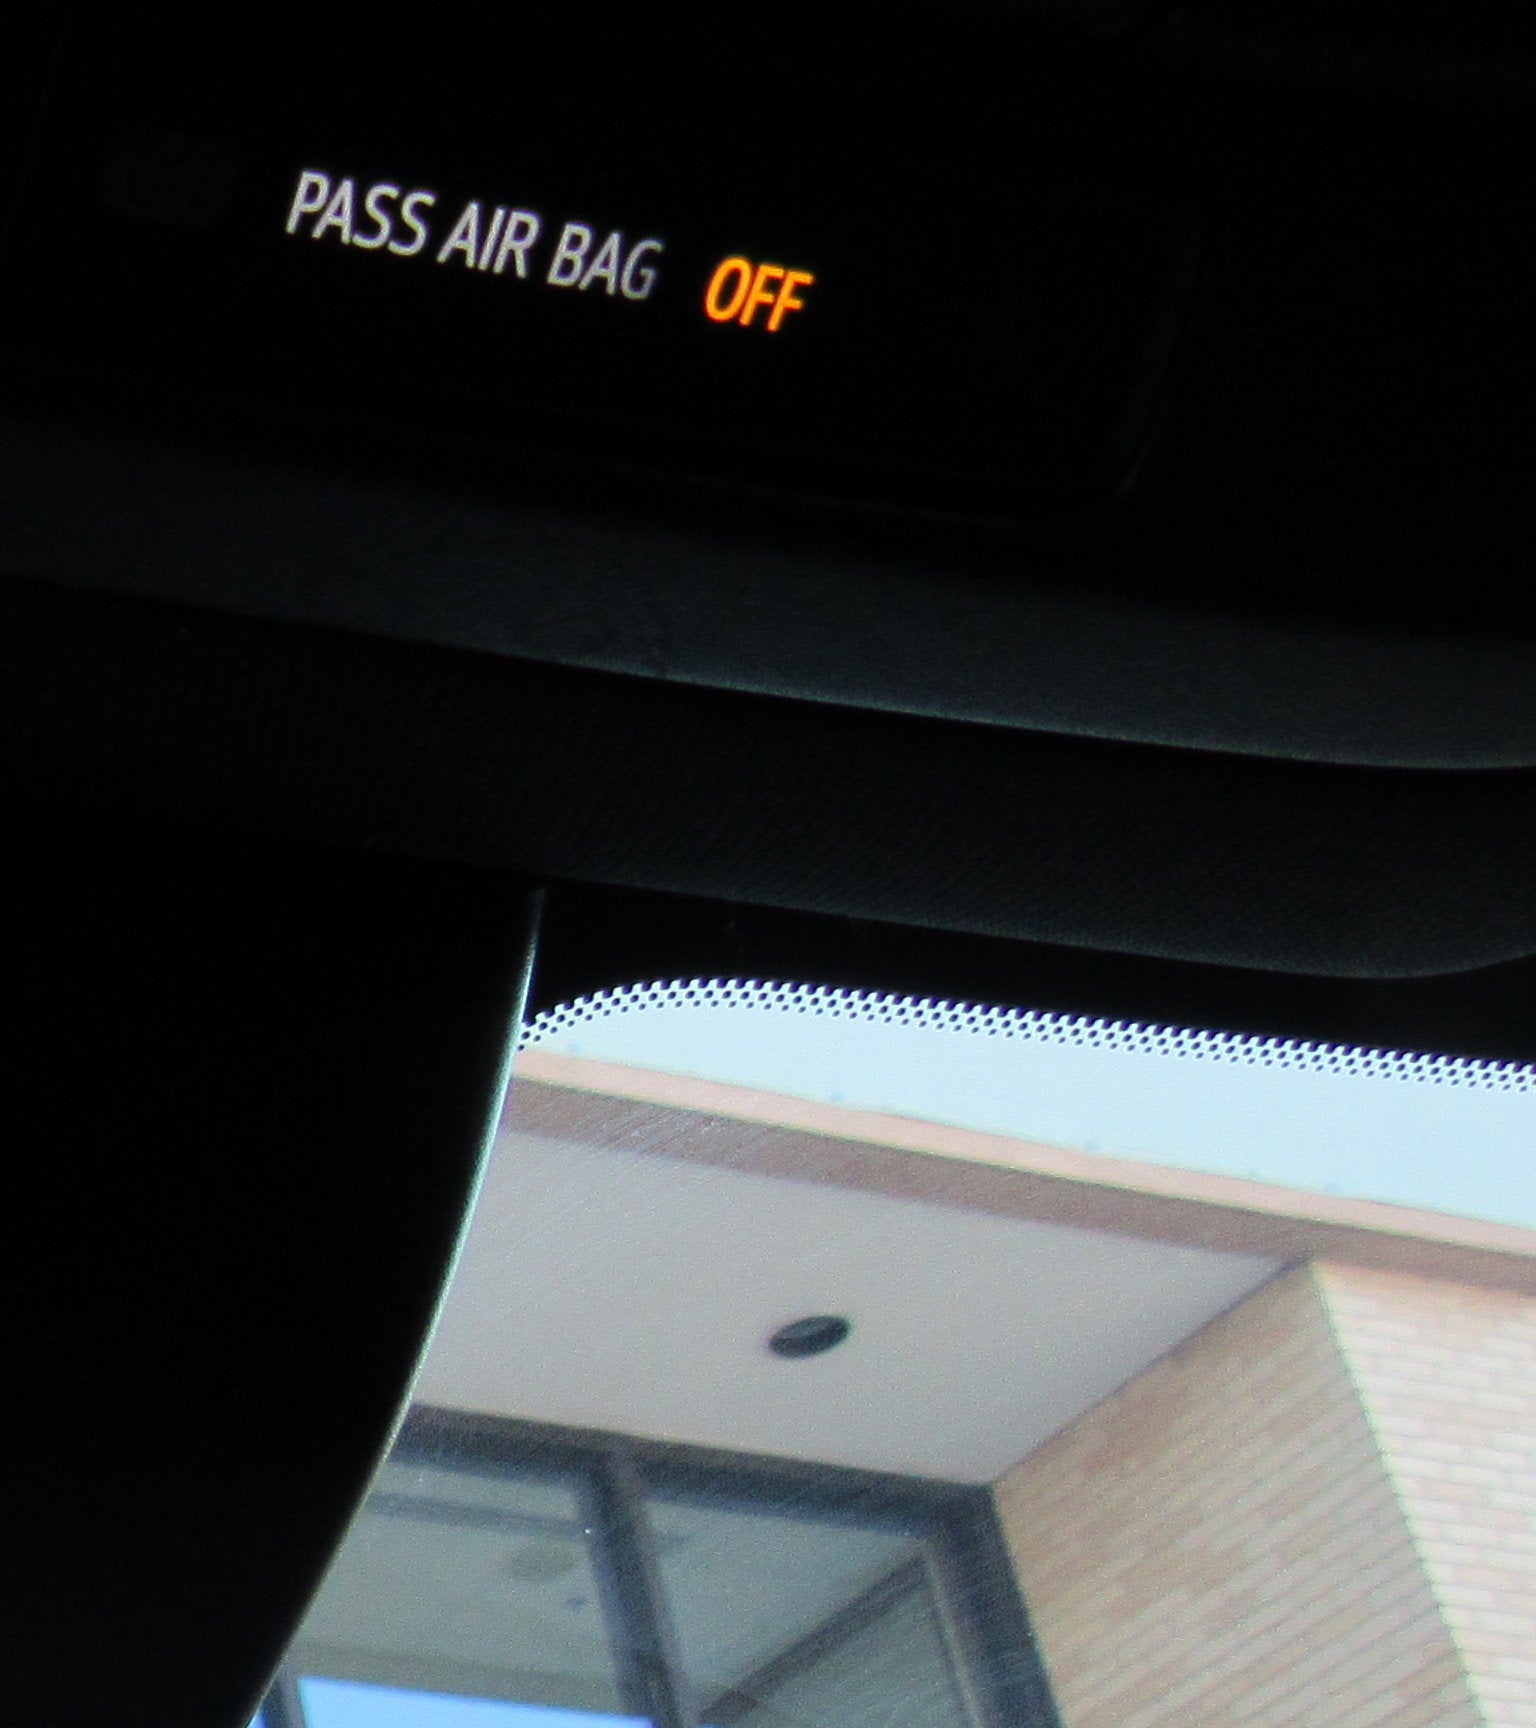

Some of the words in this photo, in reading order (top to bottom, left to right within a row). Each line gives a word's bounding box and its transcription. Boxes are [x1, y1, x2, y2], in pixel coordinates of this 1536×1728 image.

[285, 170, 436, 256] PASS
[435, 201, 542, 278] AIR
[547, 222, 664, 299] BAG
[704, 255, 815, 332] OFF
